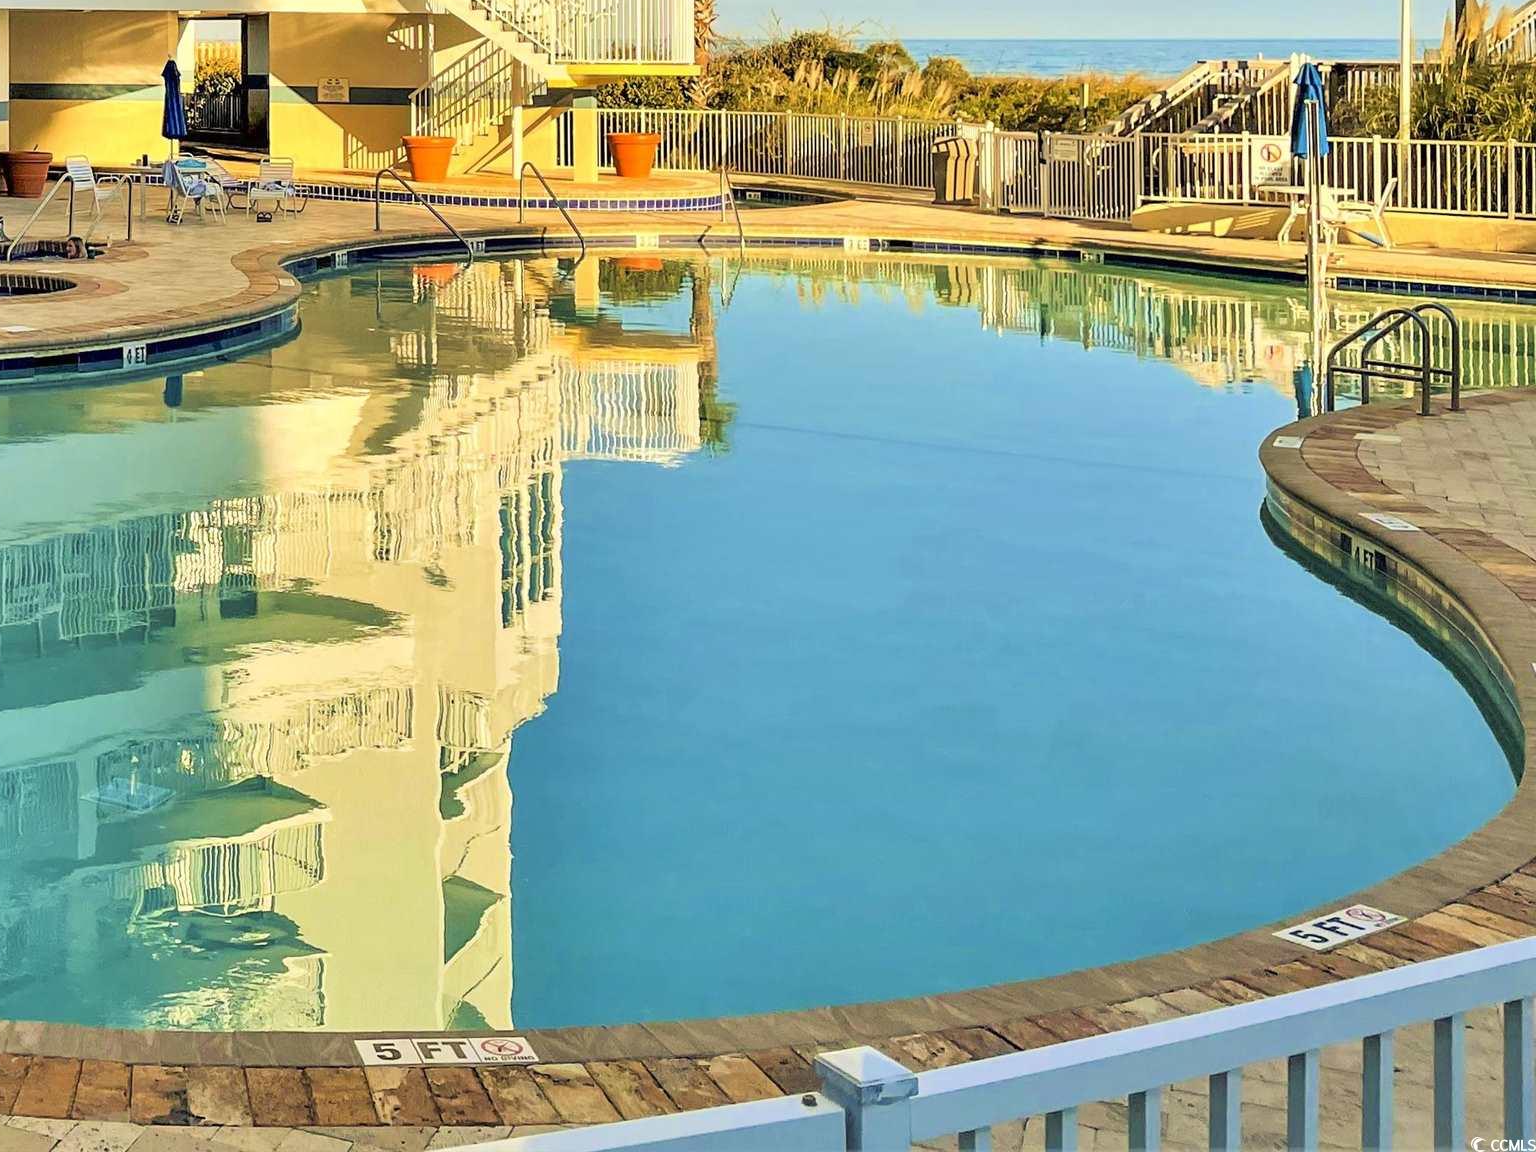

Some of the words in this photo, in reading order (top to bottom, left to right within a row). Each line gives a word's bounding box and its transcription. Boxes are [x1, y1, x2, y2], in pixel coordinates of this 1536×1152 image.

[1289, 929, 1329, 944] 5
[1311, 916, 1366, 937] FT
[372, 1042, 402, 1061] 5
[416, 1041, 468, 1060] FT
